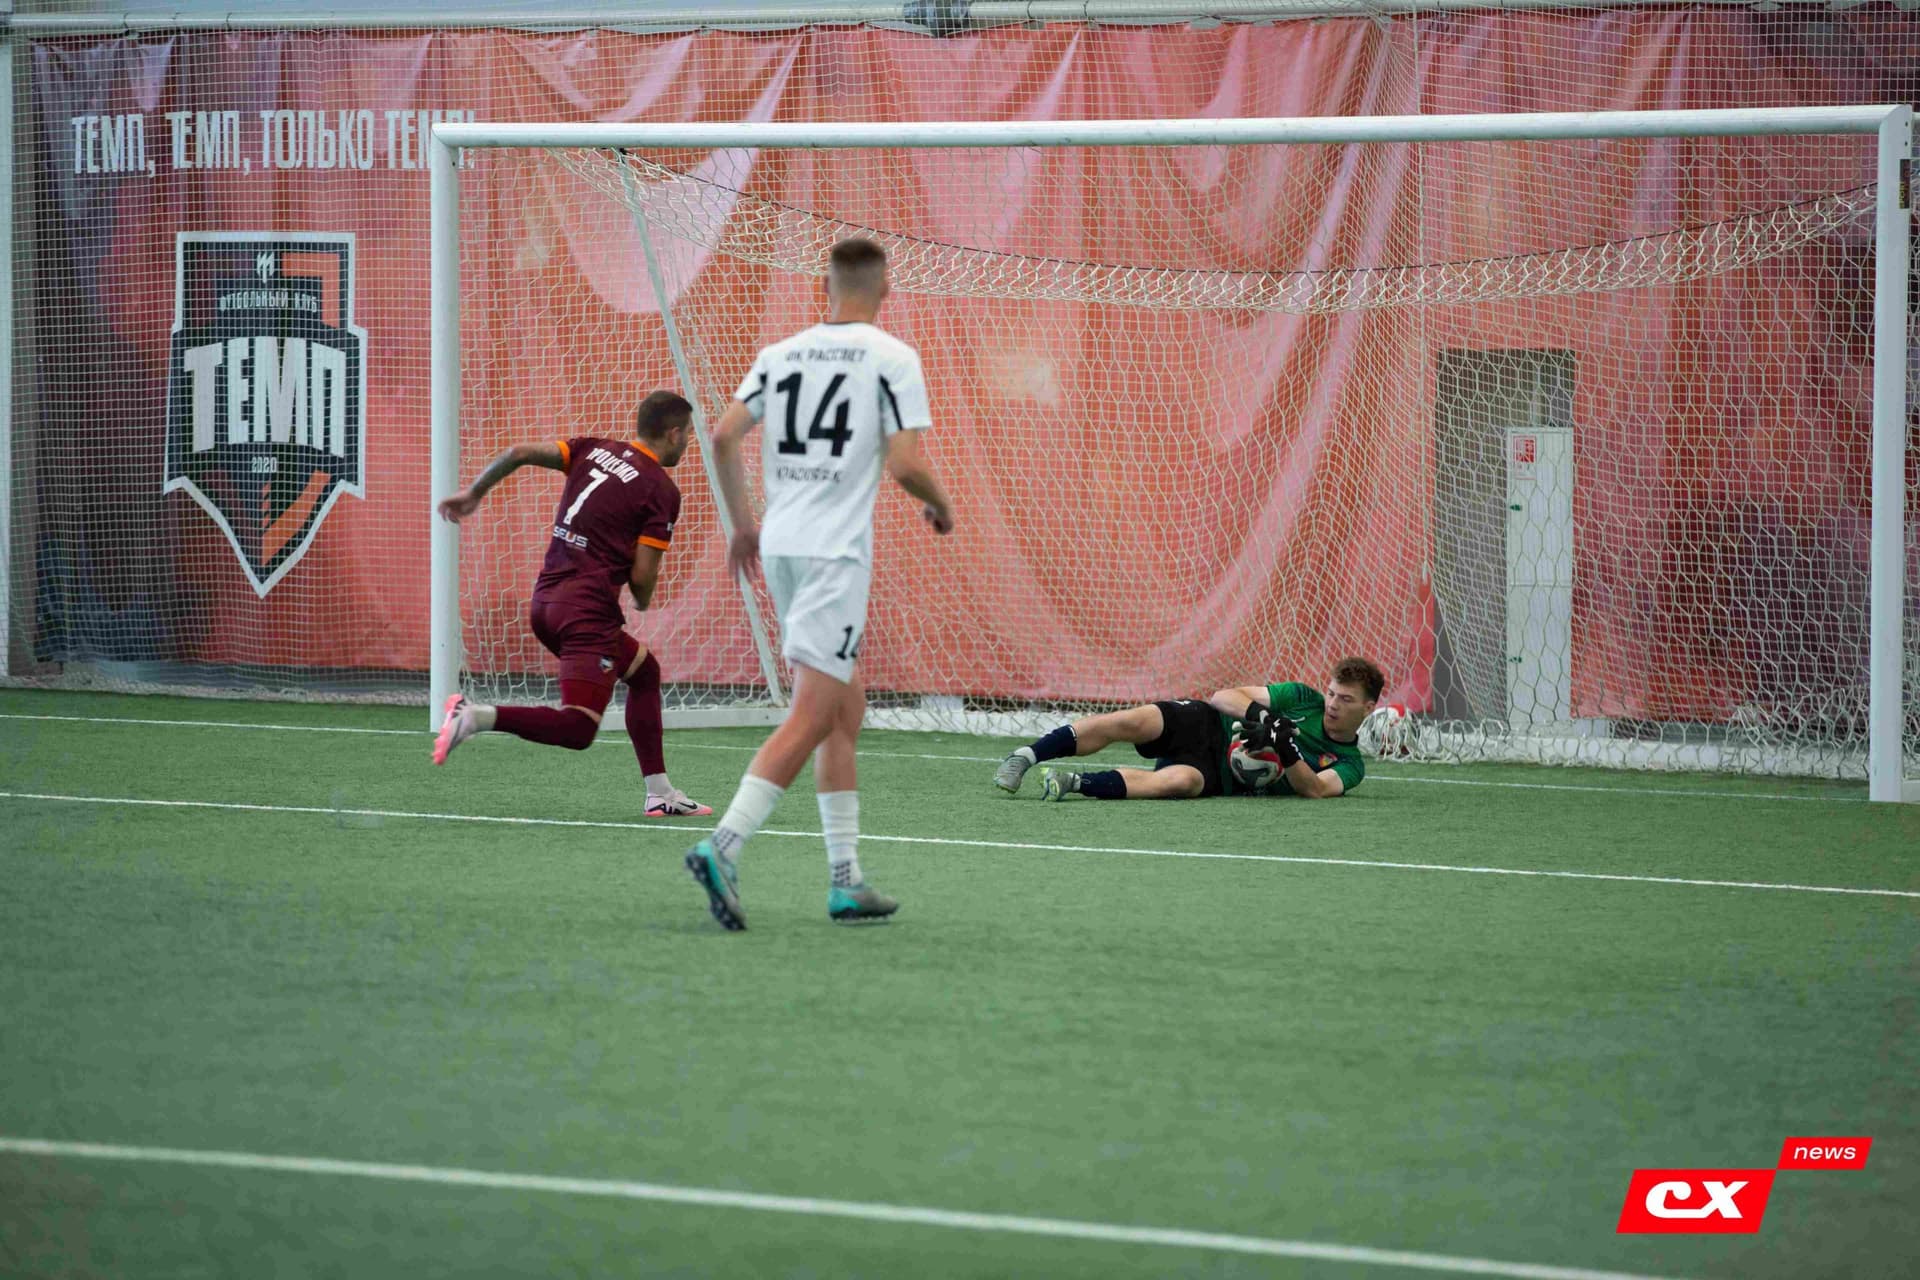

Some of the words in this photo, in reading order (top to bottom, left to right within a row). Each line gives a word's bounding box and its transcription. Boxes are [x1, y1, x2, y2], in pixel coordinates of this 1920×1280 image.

[72, 113, 156, 178] ТЕМП,
[165, 111, 250, 176] ТЕМП,
[260, 109, 375, 170] ТОЛЬКО
[294, 291, 318, 313] КЛУБ
[183, 335, 347, 459] ТЕМП
[776, 370, 854, 458] 14
[251, 456, 278, 473] 2020
[562, 467, 610, 526] 7
